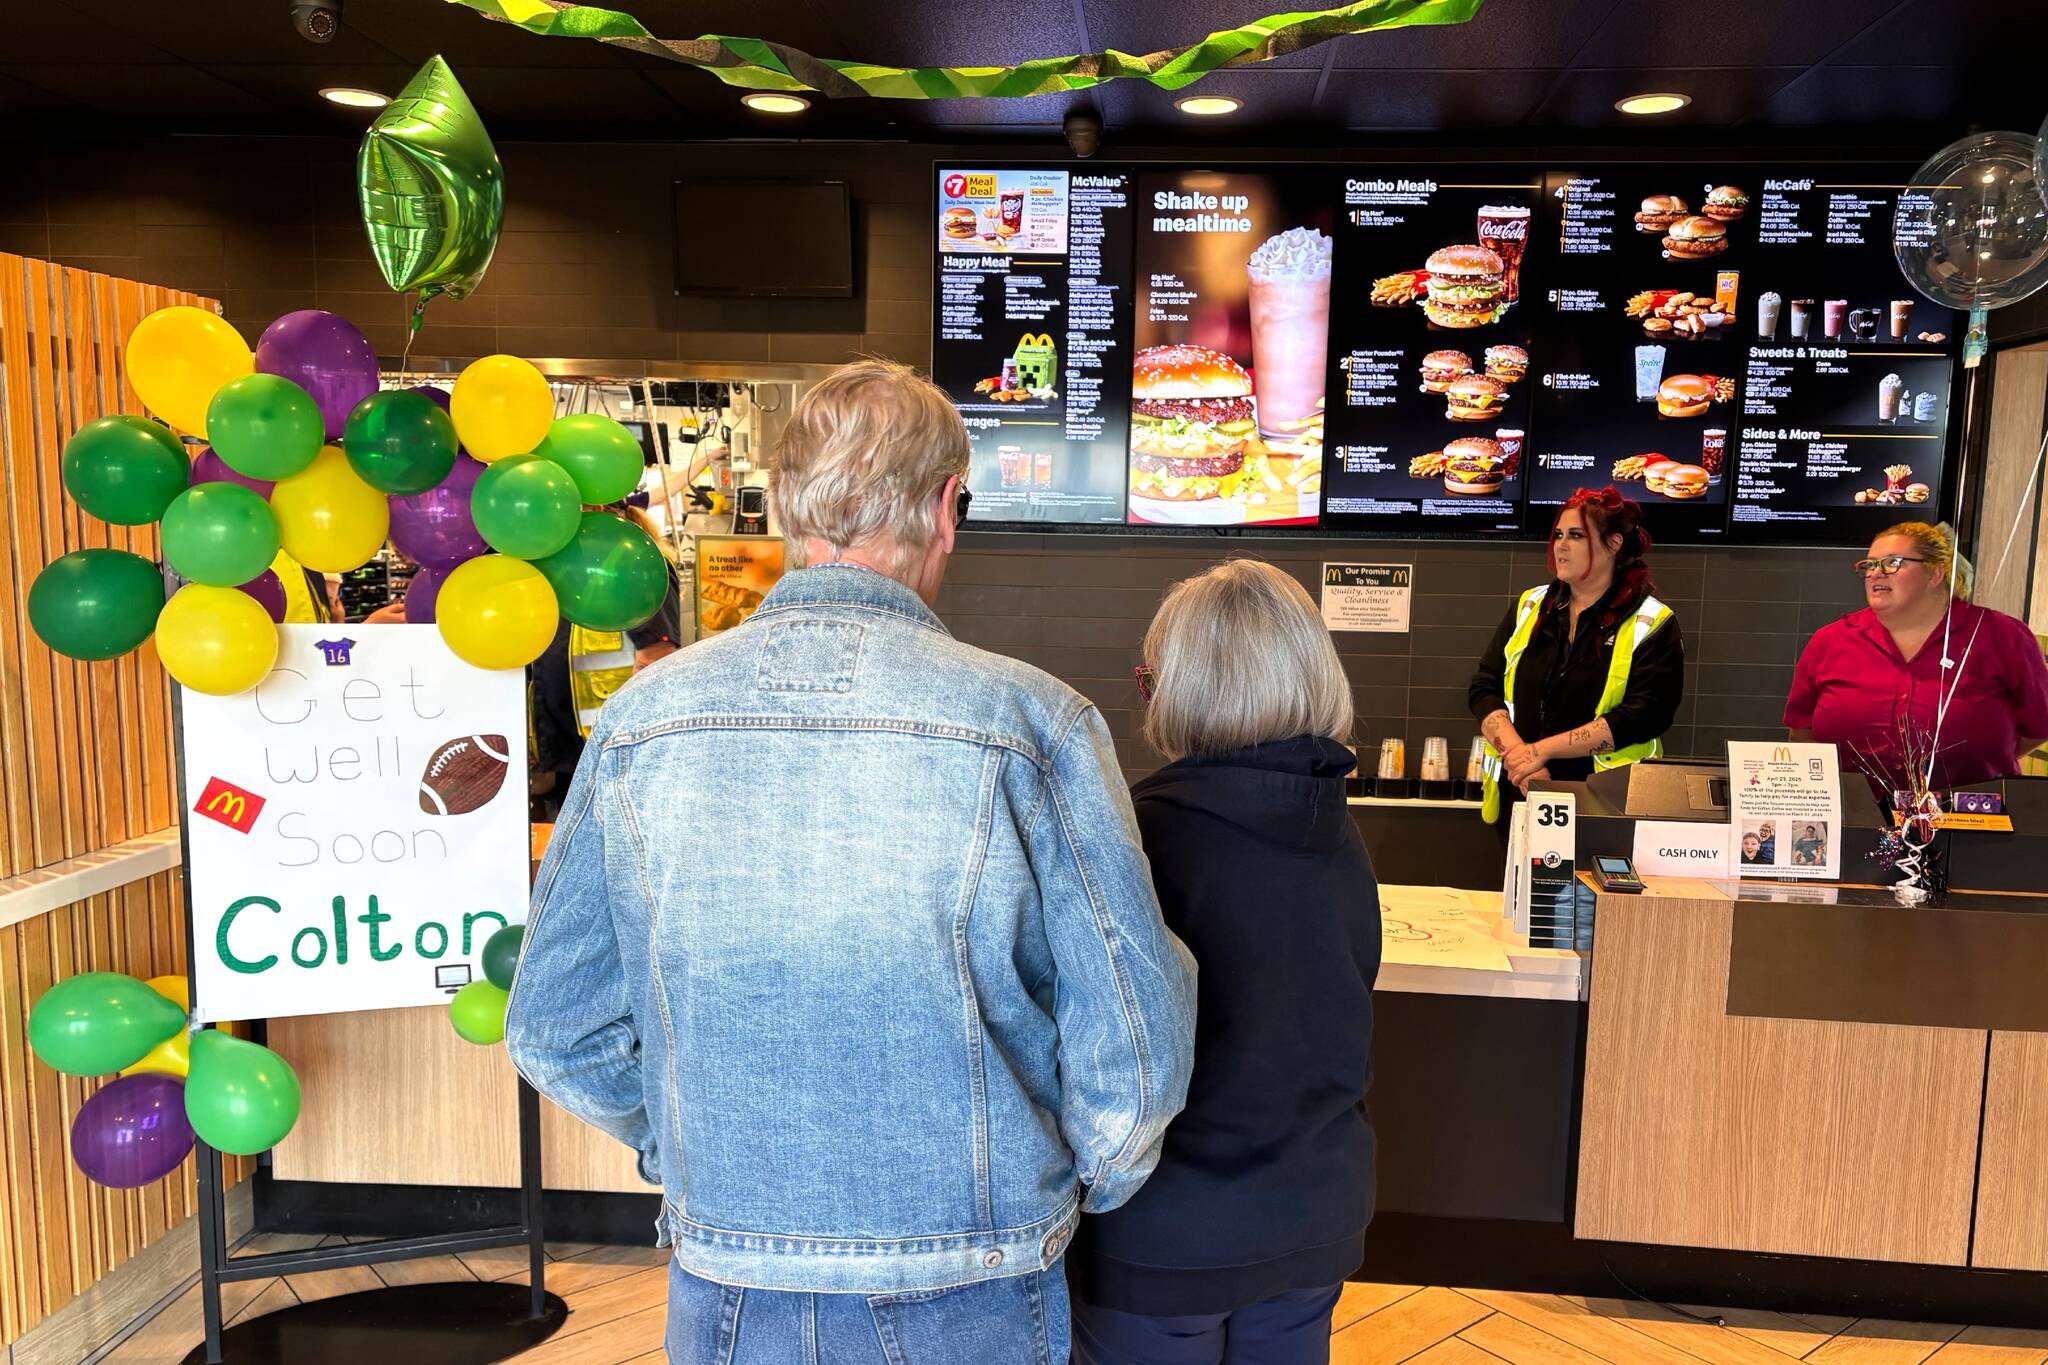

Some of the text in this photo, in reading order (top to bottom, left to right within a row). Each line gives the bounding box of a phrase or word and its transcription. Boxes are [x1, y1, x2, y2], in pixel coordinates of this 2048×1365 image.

[1072, 176, 1121, 186] McValue
[1346, 179, 1437, 192] Combo Meals
[1764, 179, 1811, 190] McCafé
[970, 187, 992, 195] Deal
[1555, 187, 1564, 198] 4
[1154, 192, 1248, 214] Shake up
[1349, 211, 1355, 222] 1
[1153, 213, 1251, 232] mealtime
[943, 256, 1010, 268] Happy Meal
[1548, 290, 1557, 302] 5
[1750, 347, 1847, 358] Sweets & Treats
[1340, 358, 1348, 369] 2
[1543, 374, 1551, 386] 6
[962, 418, 1000, 427] erages
[1743, 428, 1821, 440] Sides & More
[1704, 439, 1724, 448] Coke
[1335, 446, 1344, 458] 3
[1538, 455, 1547, 466] 7
[1331, 588, 1363, 596] Quality,
[1345, 596, 1389, 604] Cleanliness
[329, 649, 345, 663] 16
[256, 667, 445, 724] Get
[1538, 804, 1568, 827] 35
[277, 812, 447, 866] Soon
[1659, 848, 1718, 859] CASH ONLY
[216, 894, 509, 974] Colton
